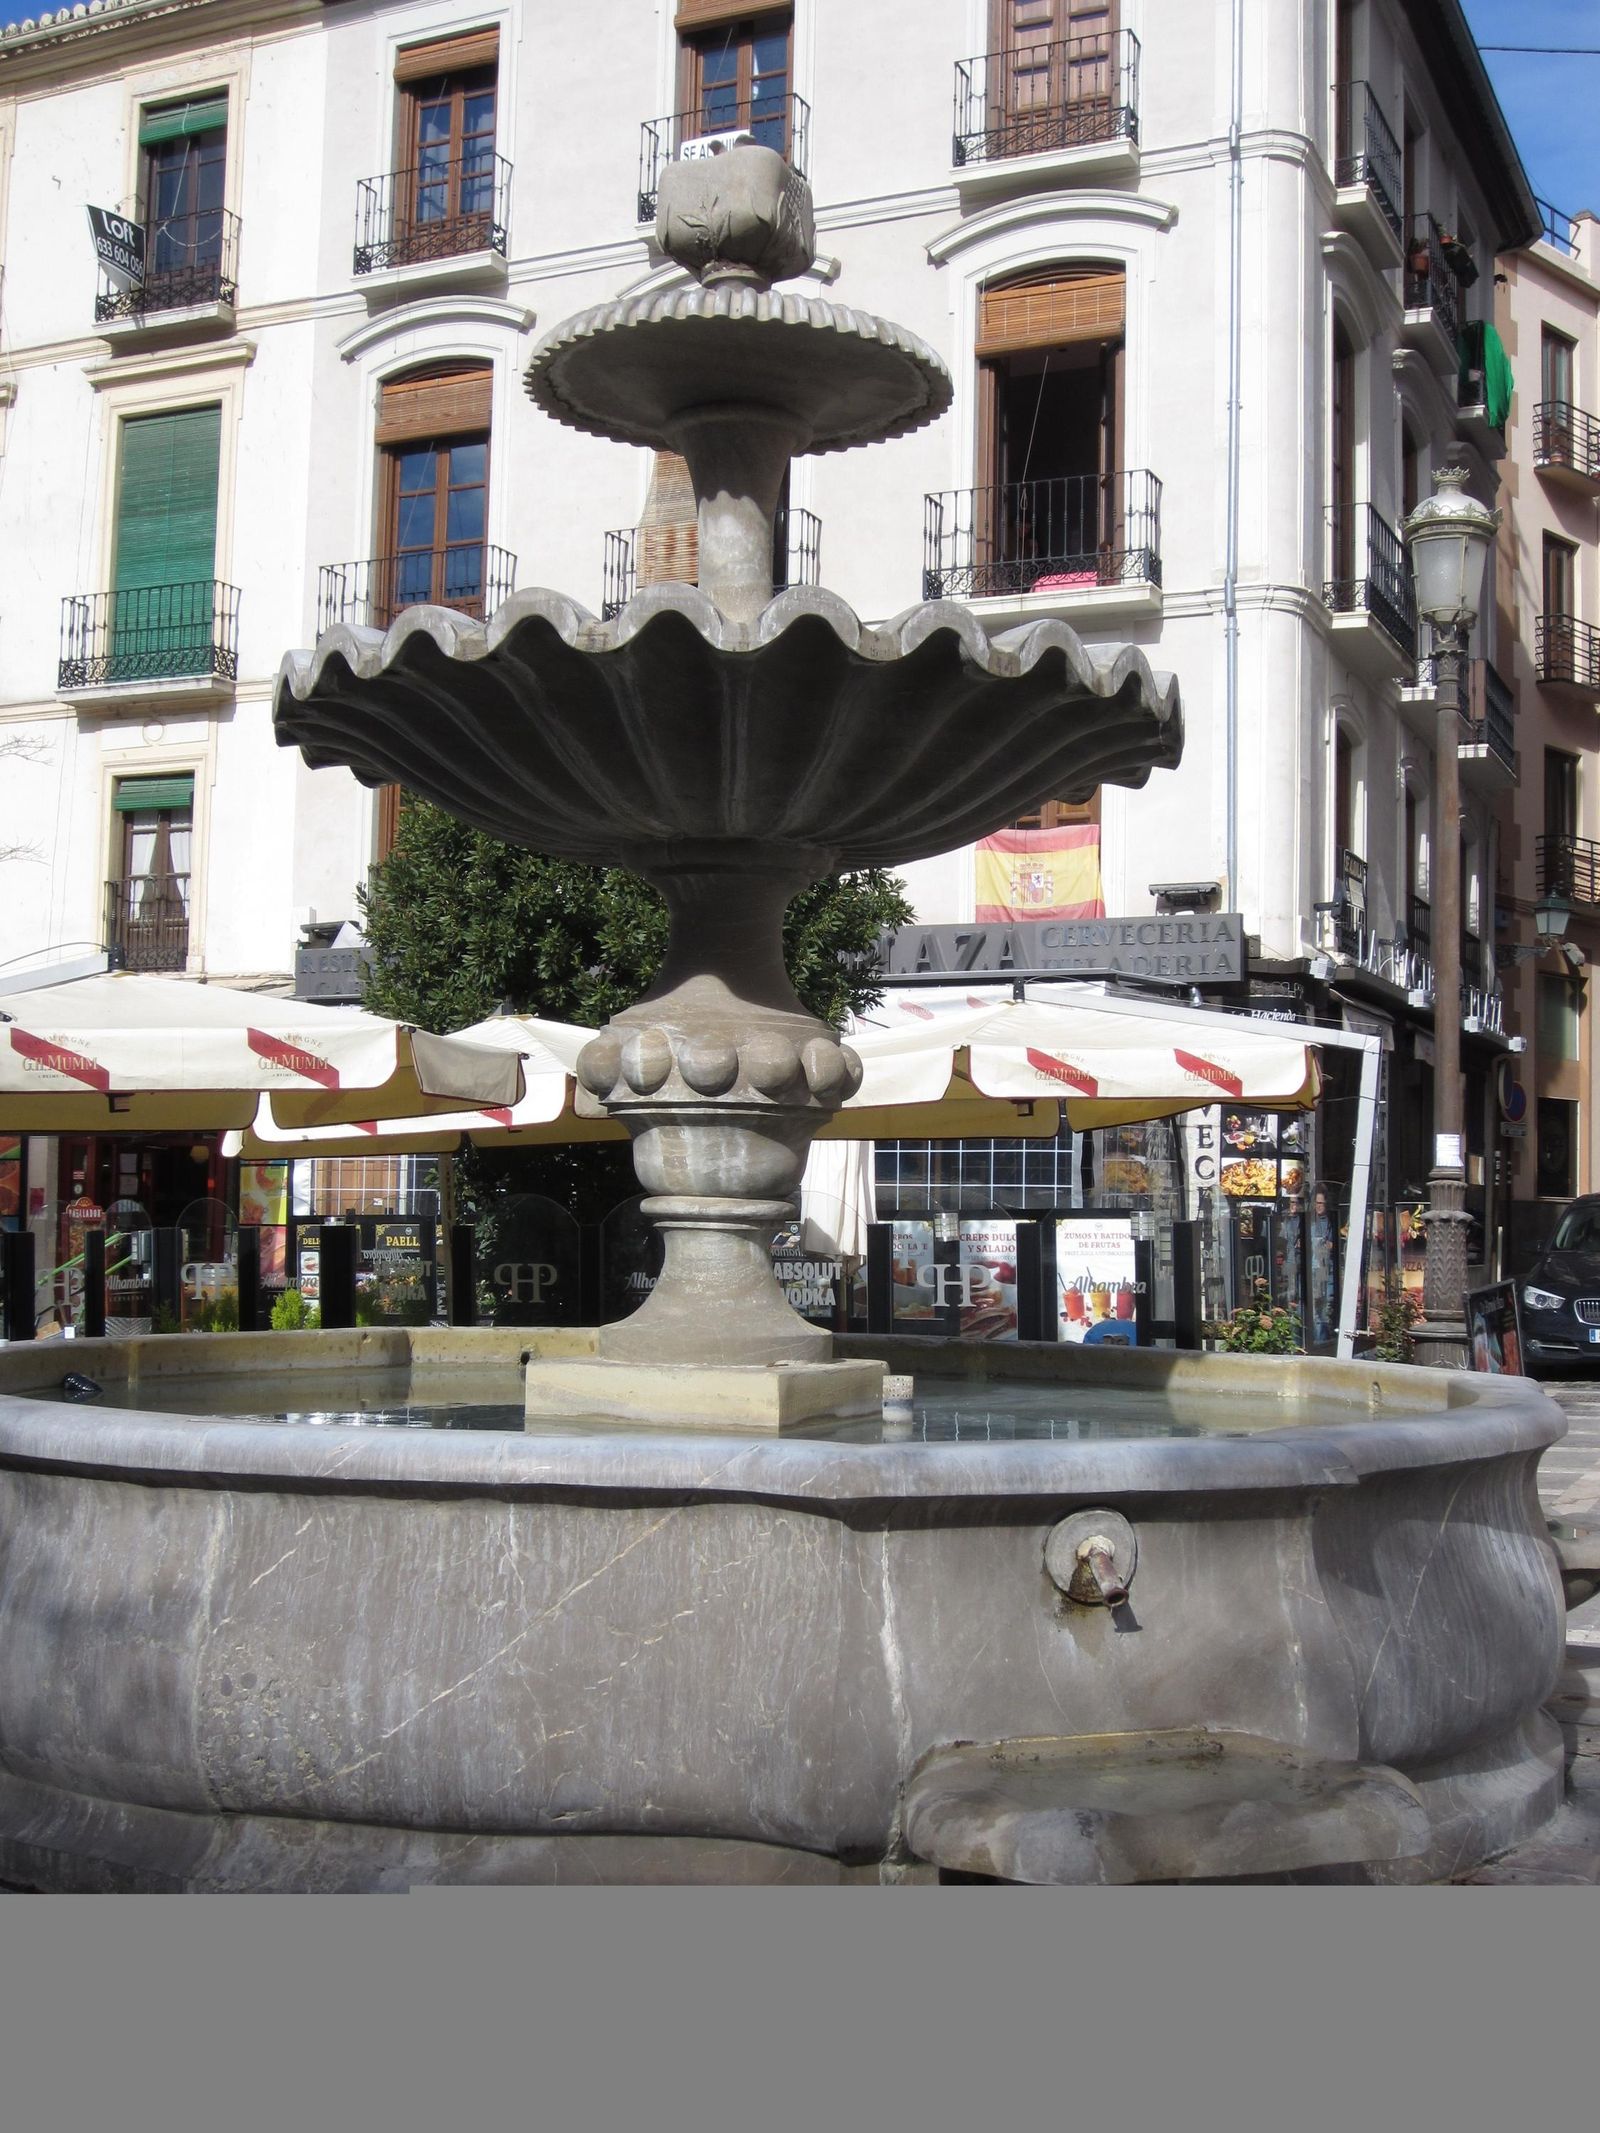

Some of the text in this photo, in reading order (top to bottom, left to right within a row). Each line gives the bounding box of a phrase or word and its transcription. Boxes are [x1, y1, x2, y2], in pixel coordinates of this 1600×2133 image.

[97, 237, 113, 257] 633
[114, 245, 129, 267] 604
[130, 255, 143, 277] 056
[1042, 922, 1235, 948] CERVECERIA
[1251, 1008, 1296, 1022] Hacienda
[960, 1233, 989, 1241] CREPS
[968, 1245, 974, 1253] Y
[773, 1262, 842, 1281] ABSOLUT
[1068, 1276, 1147, 1294] Alhambra
[781, 1288, 836, 1306] VODKA
